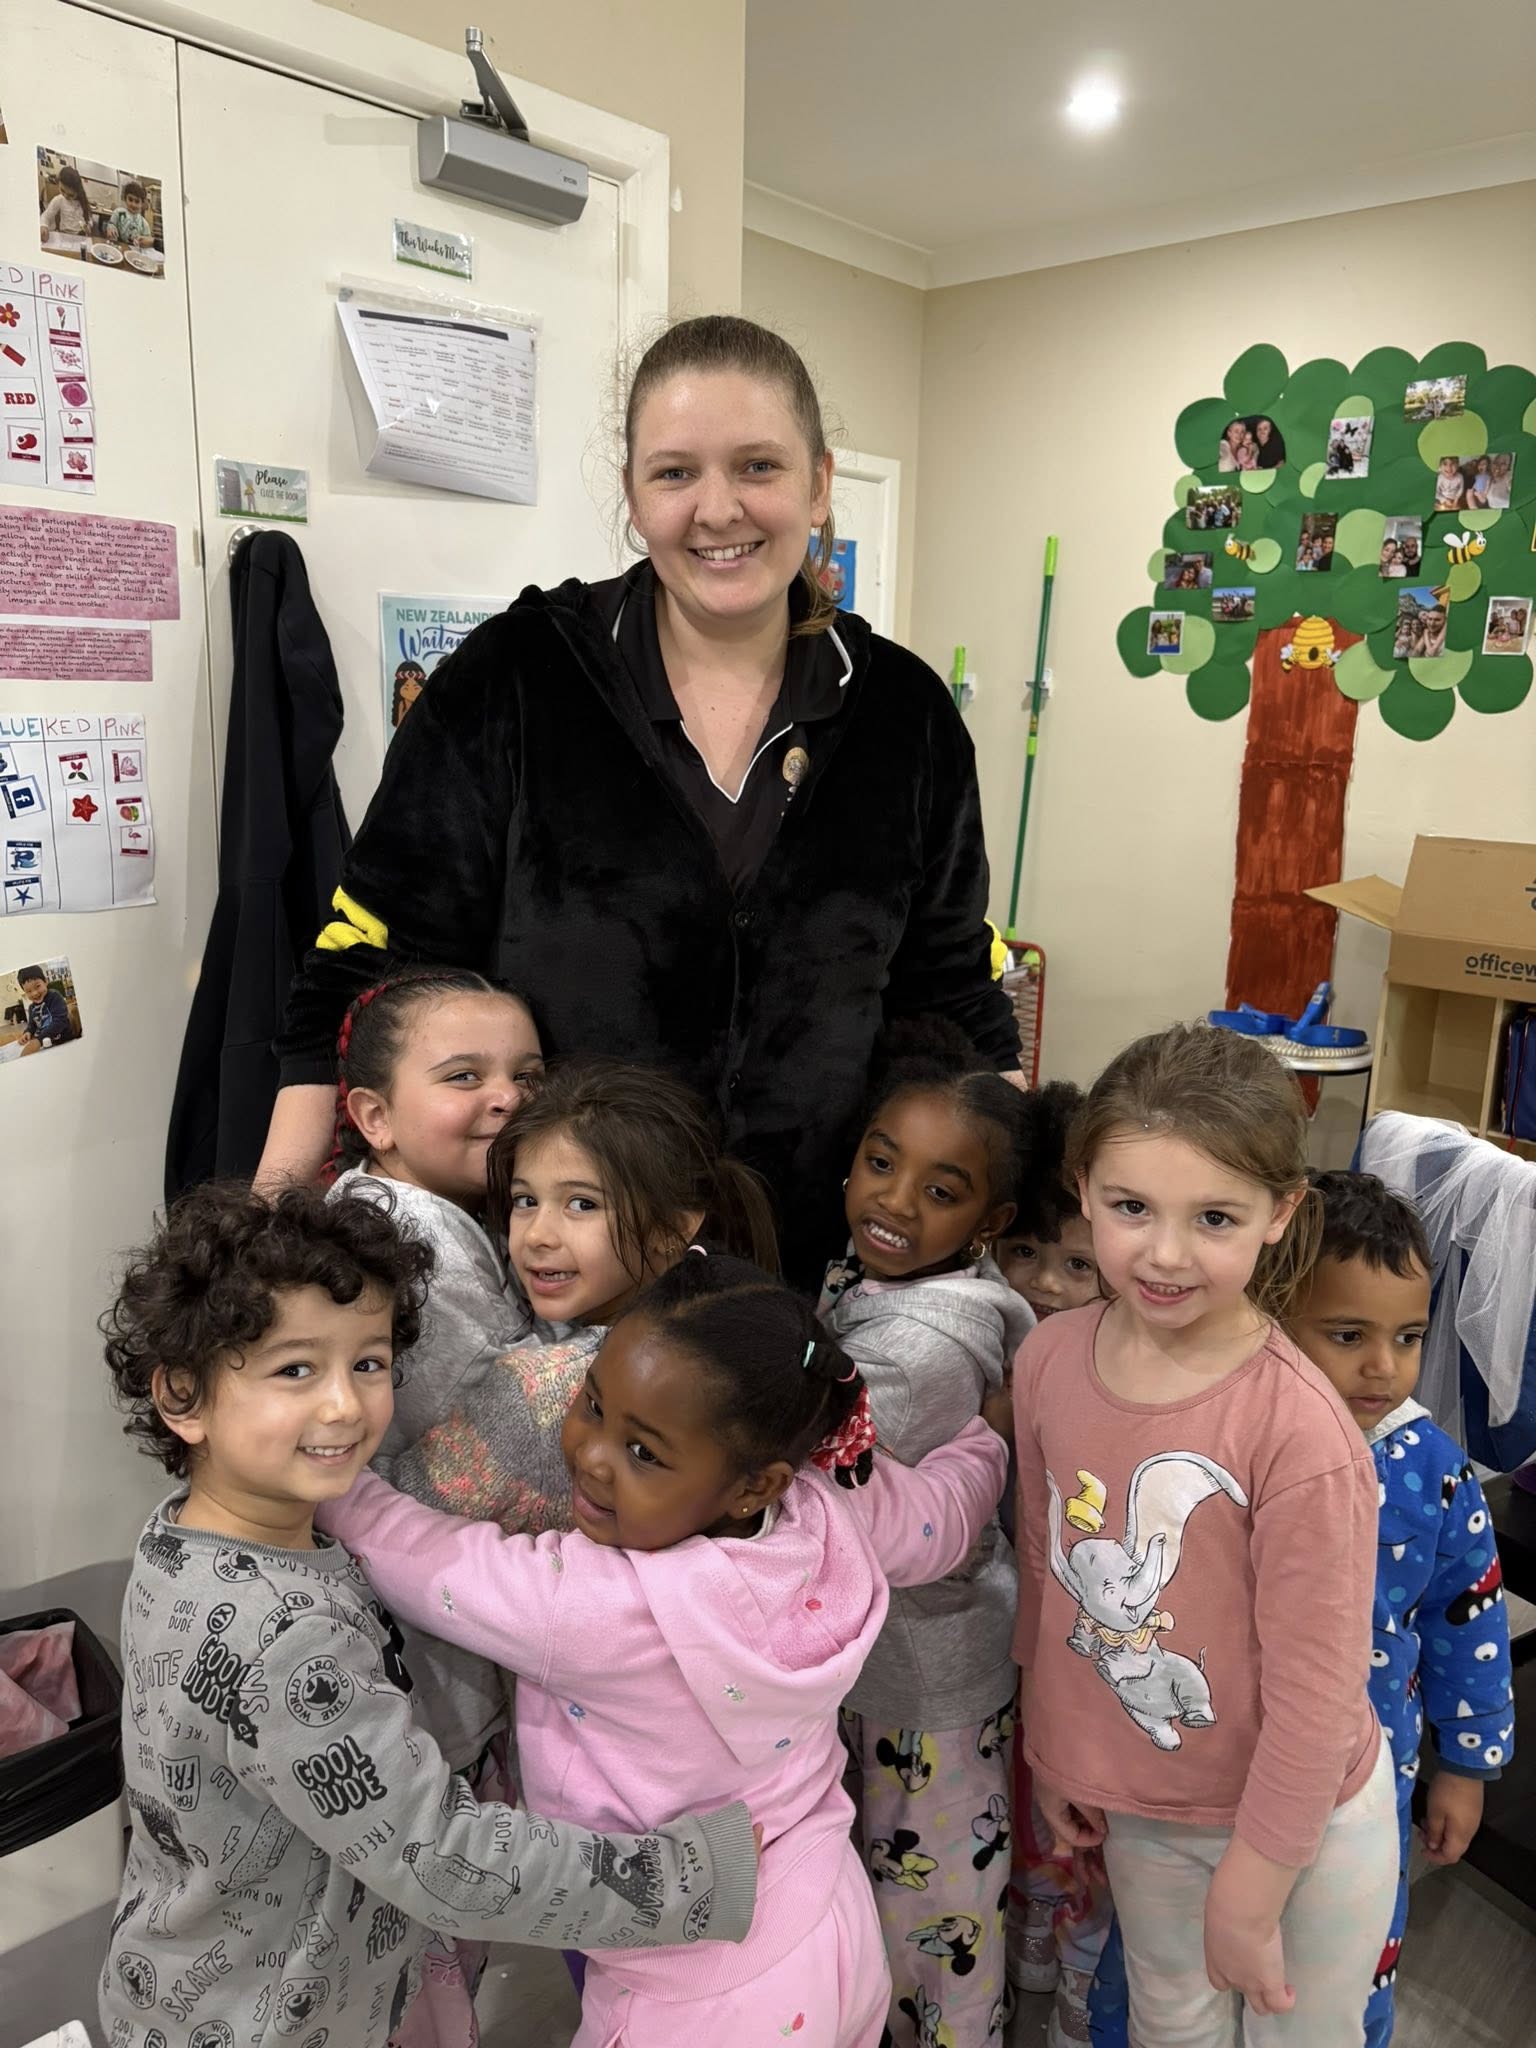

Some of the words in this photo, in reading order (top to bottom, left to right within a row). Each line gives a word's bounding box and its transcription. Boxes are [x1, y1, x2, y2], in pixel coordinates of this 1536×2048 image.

[398, 230, 416, 248] This
[39, 273, 79, 299] PINK
[3, 392, 36, 405] RED
[255, 469, 288, 487] Please
[276, 490, 284, 500] THE
[285, 491, 299, 502] DOOR
[4, 515, 27, 523] eager
[42, 517, 81, 527] participate
[96, 521, 107, 529] the
[111, 523, 131, 531] color
[134, 526, 167, 536] matching
[23, 524, 41, 532] their
[45, 526, 70, 537] ability
[84, 531, 115, 541] identify
[117, 533, 140, 541] colors
[19, 542, 40, 550] often
[43, 544, 73, 555] looking
[109, 549, 141, 557] educator
[145, 551, 156, 559] for
[70, 537, 91, 545] There
[115, 543, 148, 551] moments
[1, 551, 31, 561] activity
[35, 554, 61, 562] proved
[64, 555, 103, 565] beneficial
[107, 557, 117, 565] for
[120, 559, 138, 567] their
[141, 561, 165, 569] school
[40, 571, 63, 579] motor
[66, 573, 88, 581] skills
[89, 575, 120, 584] through
[77, 565, 90, 575] key
[92, 566, 147, 577] developmental
[13, 588, 47, 597] engaged
[115, 594, 153, 604] discussing
[98, 584, 120, 592] social
[8, 596, 37, 606] images
[396, 608, 427, 622] NEW
[430, 610, 495, 624] ZEALAND'
[105, 718, 142, 737] PINK
[173, 1600, 199, 1617] COOL
[168, 1616, 195, 1633] DUDE
[197, 1633, 252, 1691] COOL
[134, 1649, 184, 1694] SATE
[306, 1660, 349, 1689] AROUND
[181, 1658, 234, 1724] DUDE
[289, 1678, 312, 1722] WORLD
[322, 1699, 348, 1721] THE
[292, 1734, 372, 1791] COOL
[308, 1763, 388, 1819] DUDE
[338, 1819, 396, 1865] FREEDO
[631, 1838, 665, 1930] ADVENTURE
[265, 1892, 283, 1908] NO
[550, 1887, 569, 1906] NO
[160, 1939, 233, 2022] SKATE
[276, 1984, 295, 2020] WORLD
